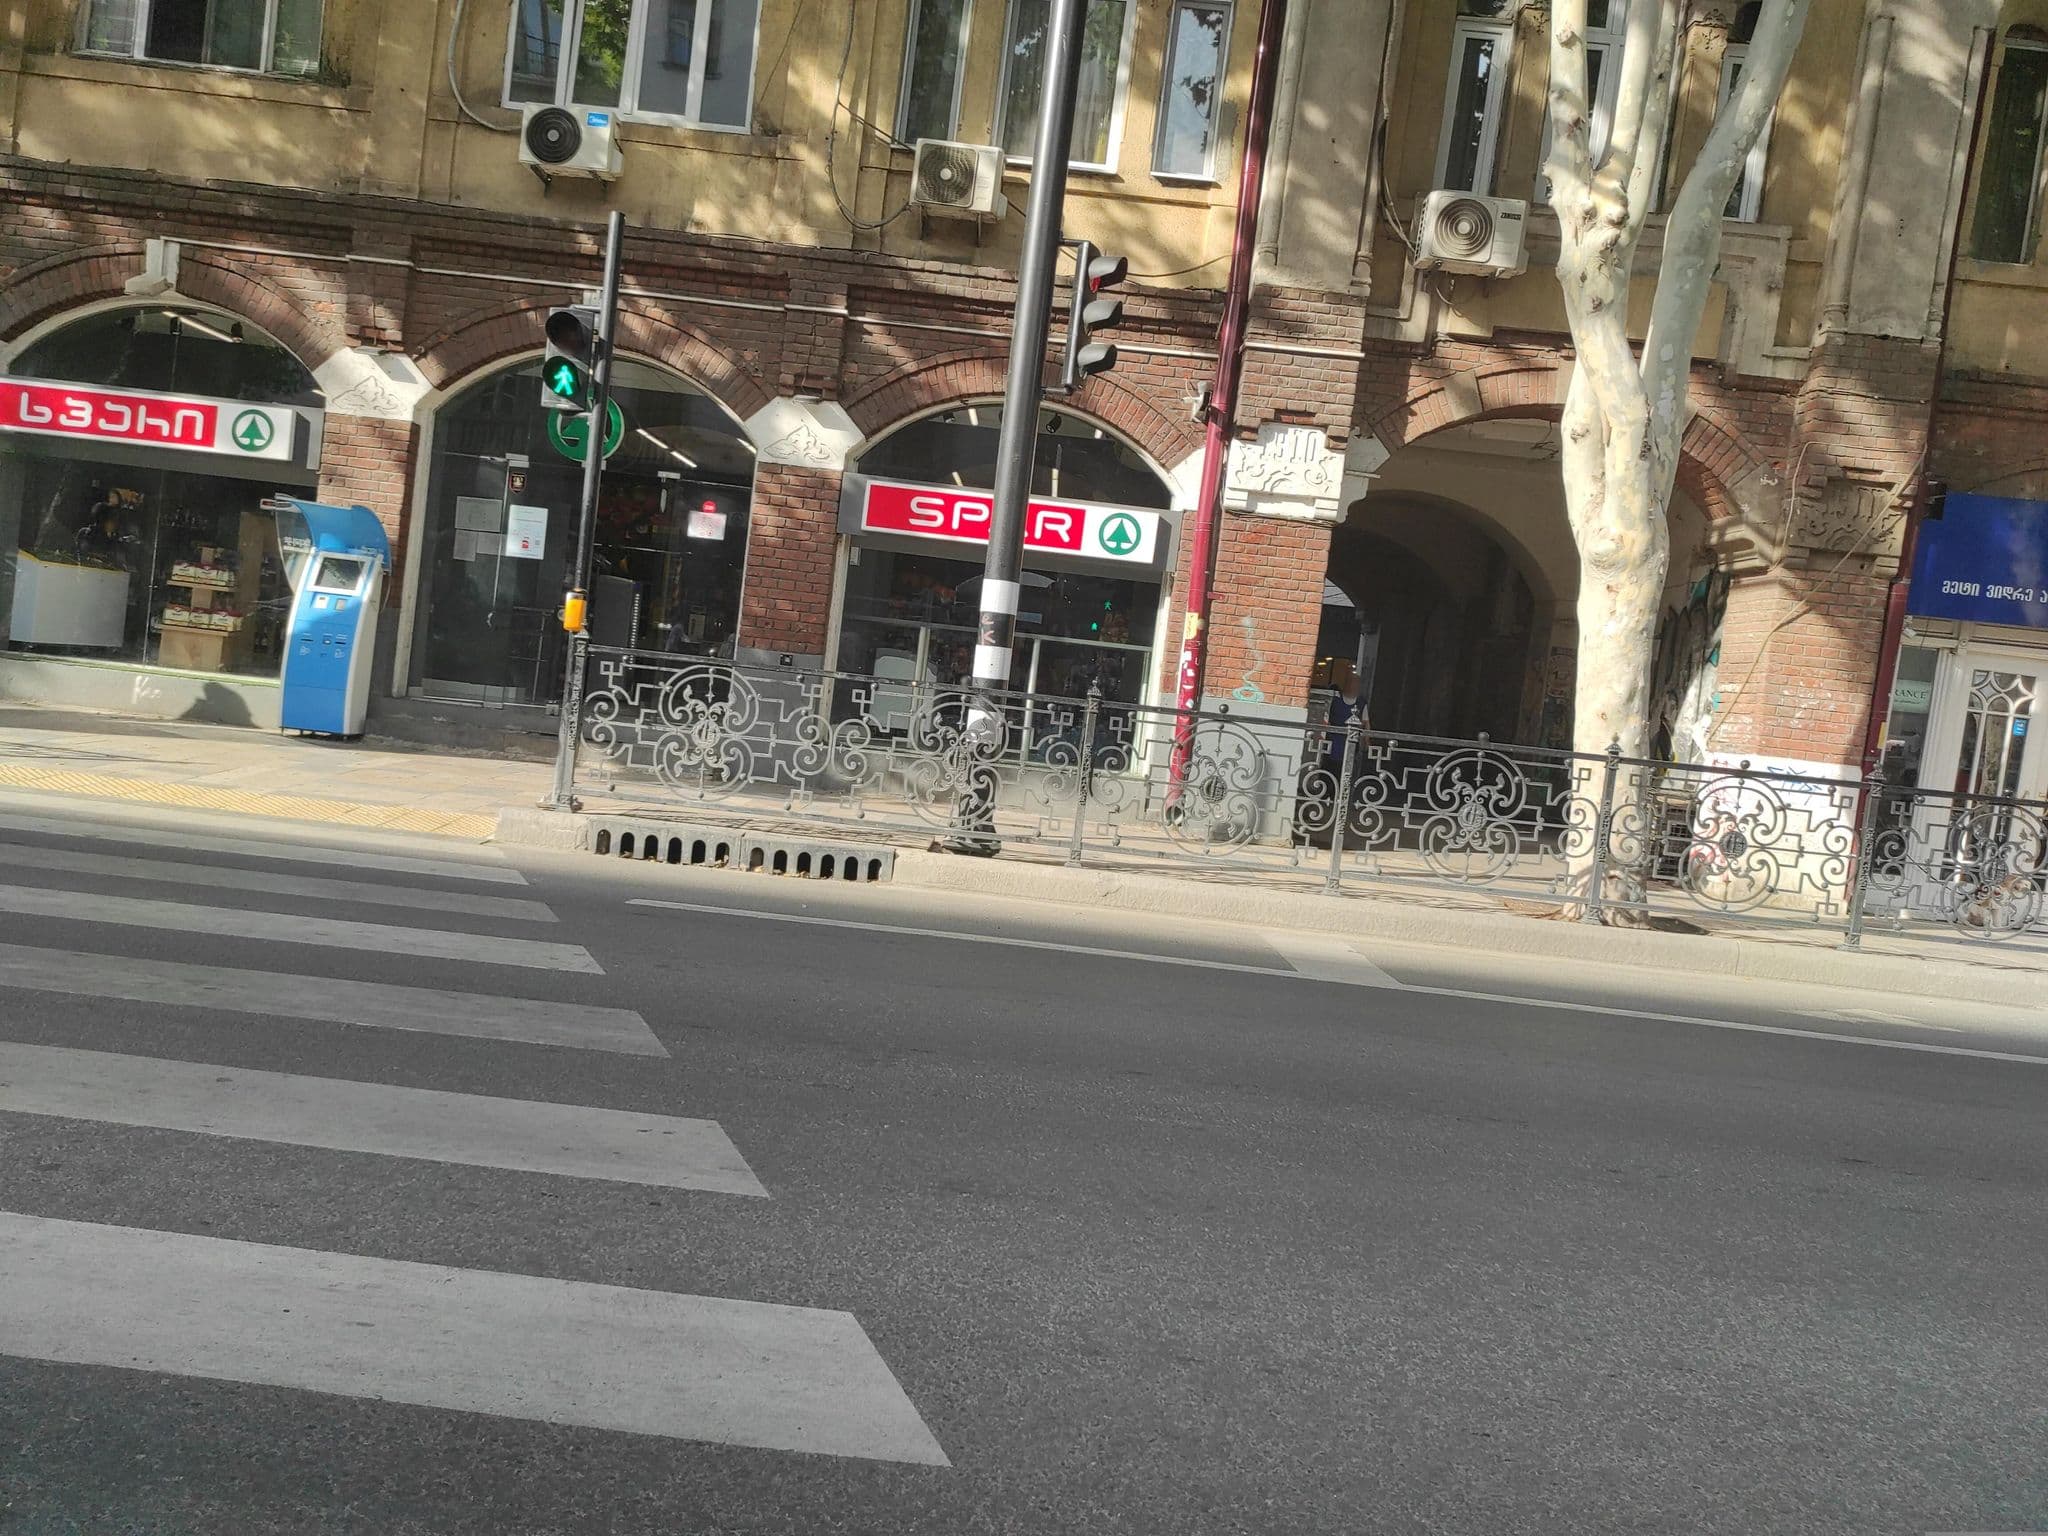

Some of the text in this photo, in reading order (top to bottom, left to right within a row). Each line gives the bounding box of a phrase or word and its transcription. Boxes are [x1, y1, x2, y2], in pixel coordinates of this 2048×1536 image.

[908, 496, 1072, 543] SPR
[1942, 580, 1981, 597] მეტი
[1986, 584, 2034, 602] ვიდრე
